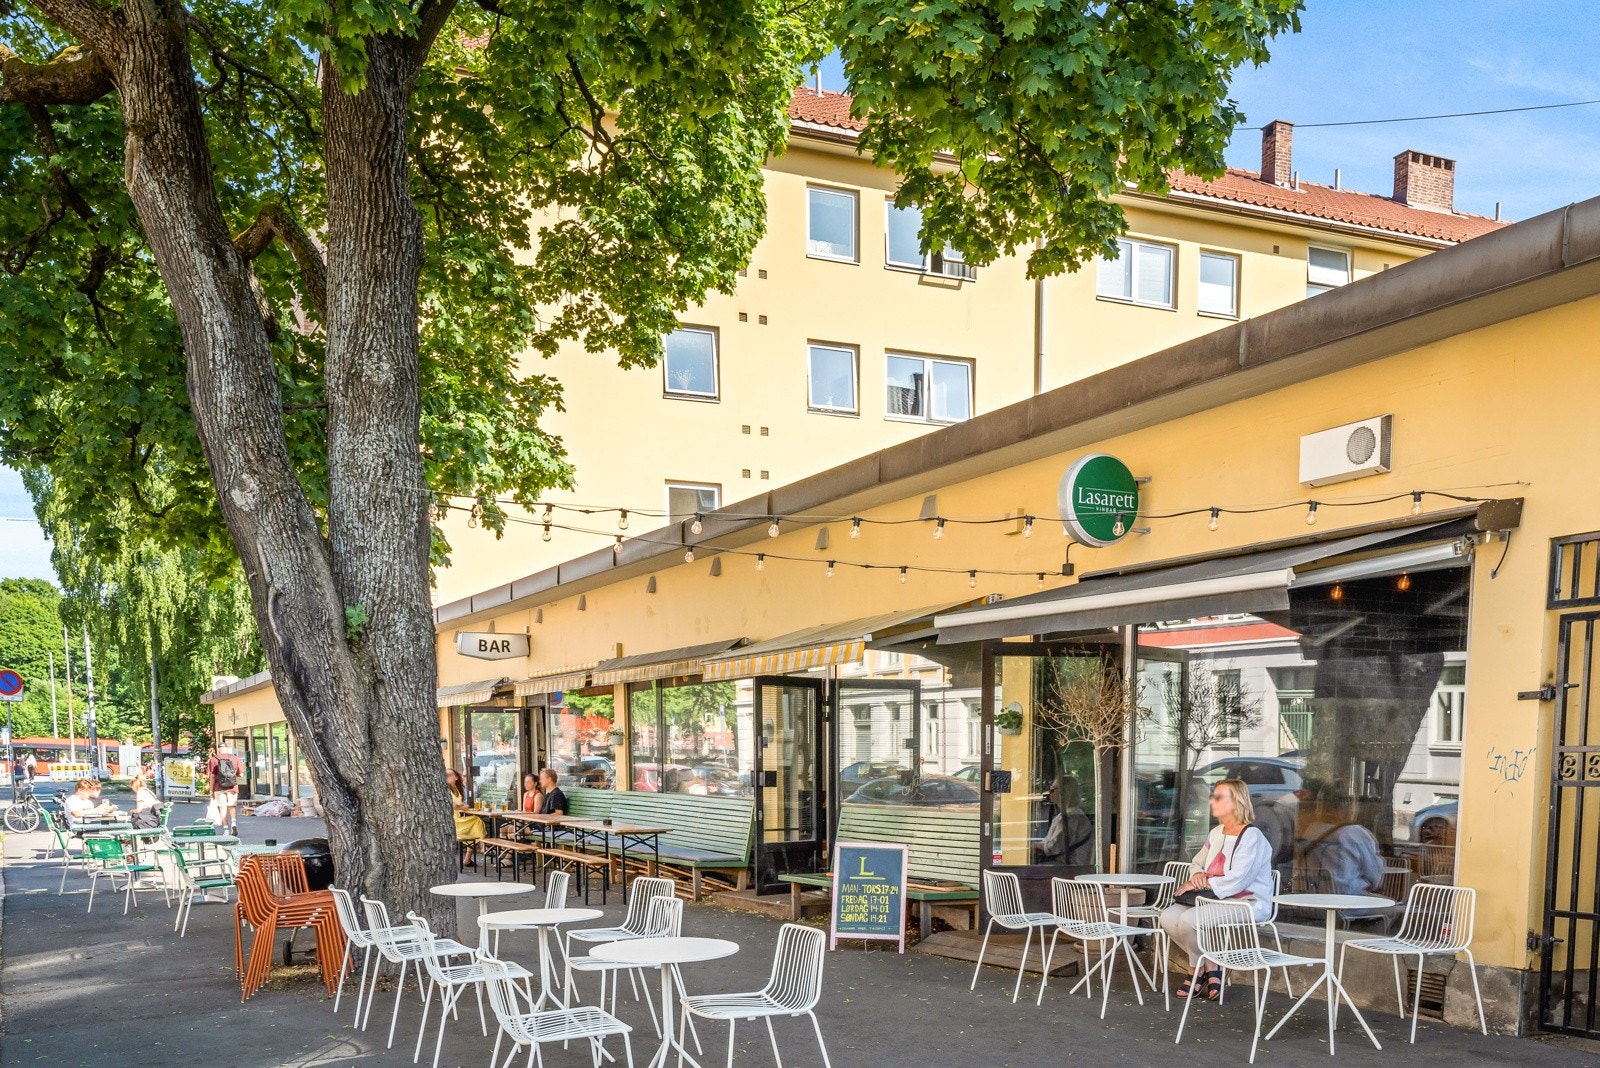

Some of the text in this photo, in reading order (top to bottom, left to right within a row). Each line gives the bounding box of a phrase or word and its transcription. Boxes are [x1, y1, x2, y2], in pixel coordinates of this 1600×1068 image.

[1078, 487, 1135, 509] Lasarett
[478, 639, 511, 653] BAR
[859, 856, 875, 876] L
[841, 895, 889, 904] FREDAG 17-01
[841, 904, 868, 913] LØRDAG
[840, 913, 887, 923] SØNDAG 14-21
